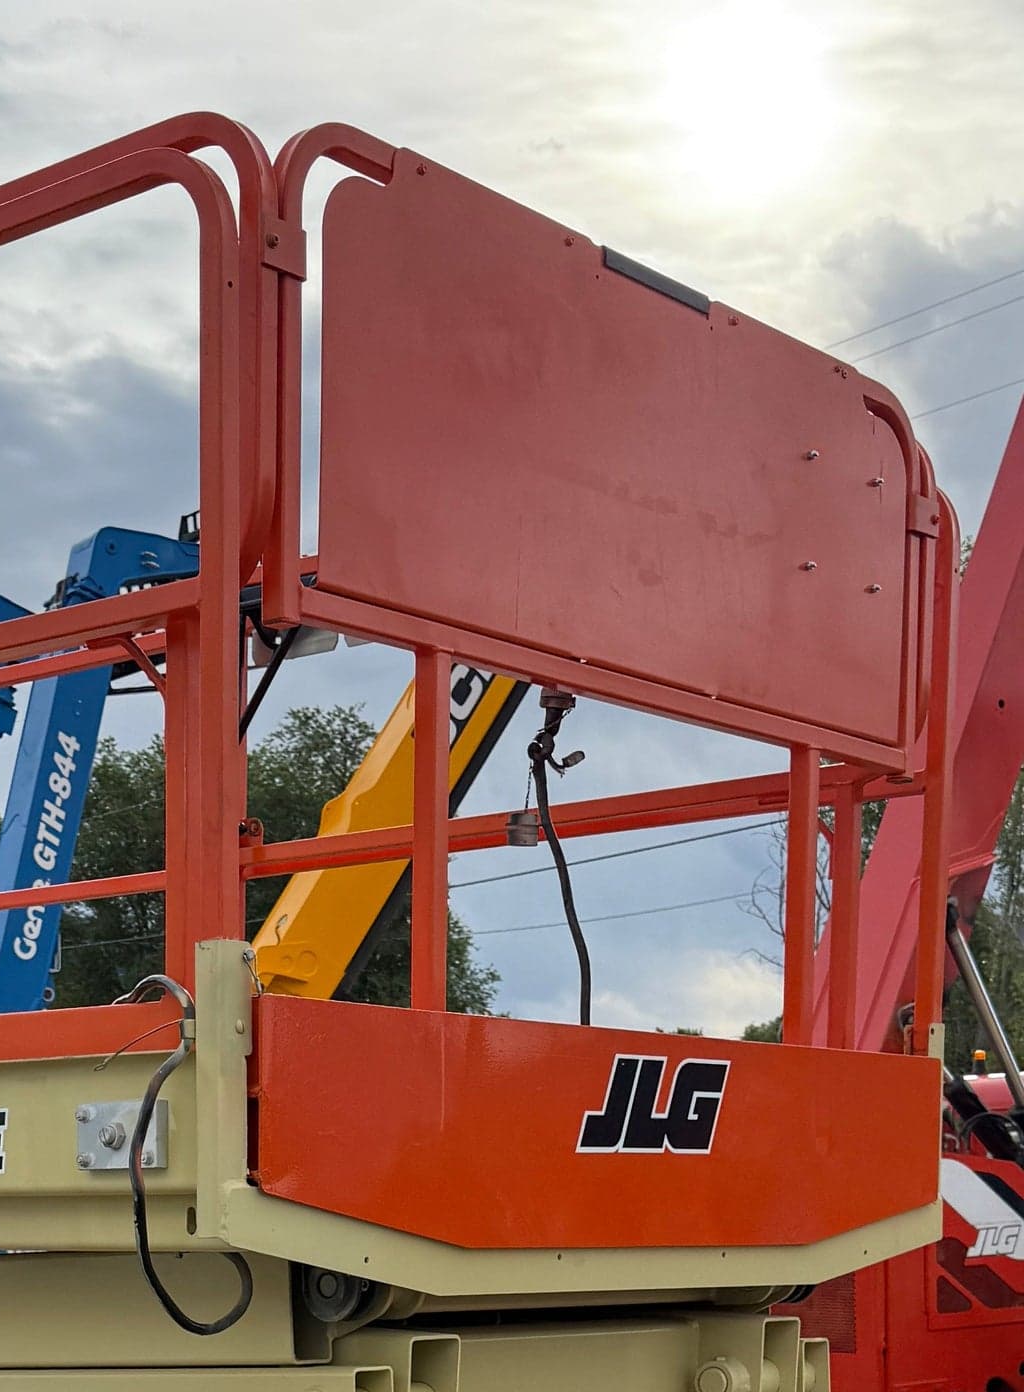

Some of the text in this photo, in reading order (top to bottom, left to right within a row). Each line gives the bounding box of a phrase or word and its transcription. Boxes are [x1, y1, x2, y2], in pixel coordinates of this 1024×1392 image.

[13, 730, 81, 960] Gen GTH-844
[576, 1054, 731, 1154] JLG
[966, 1224, 1021, 1257] JLG
